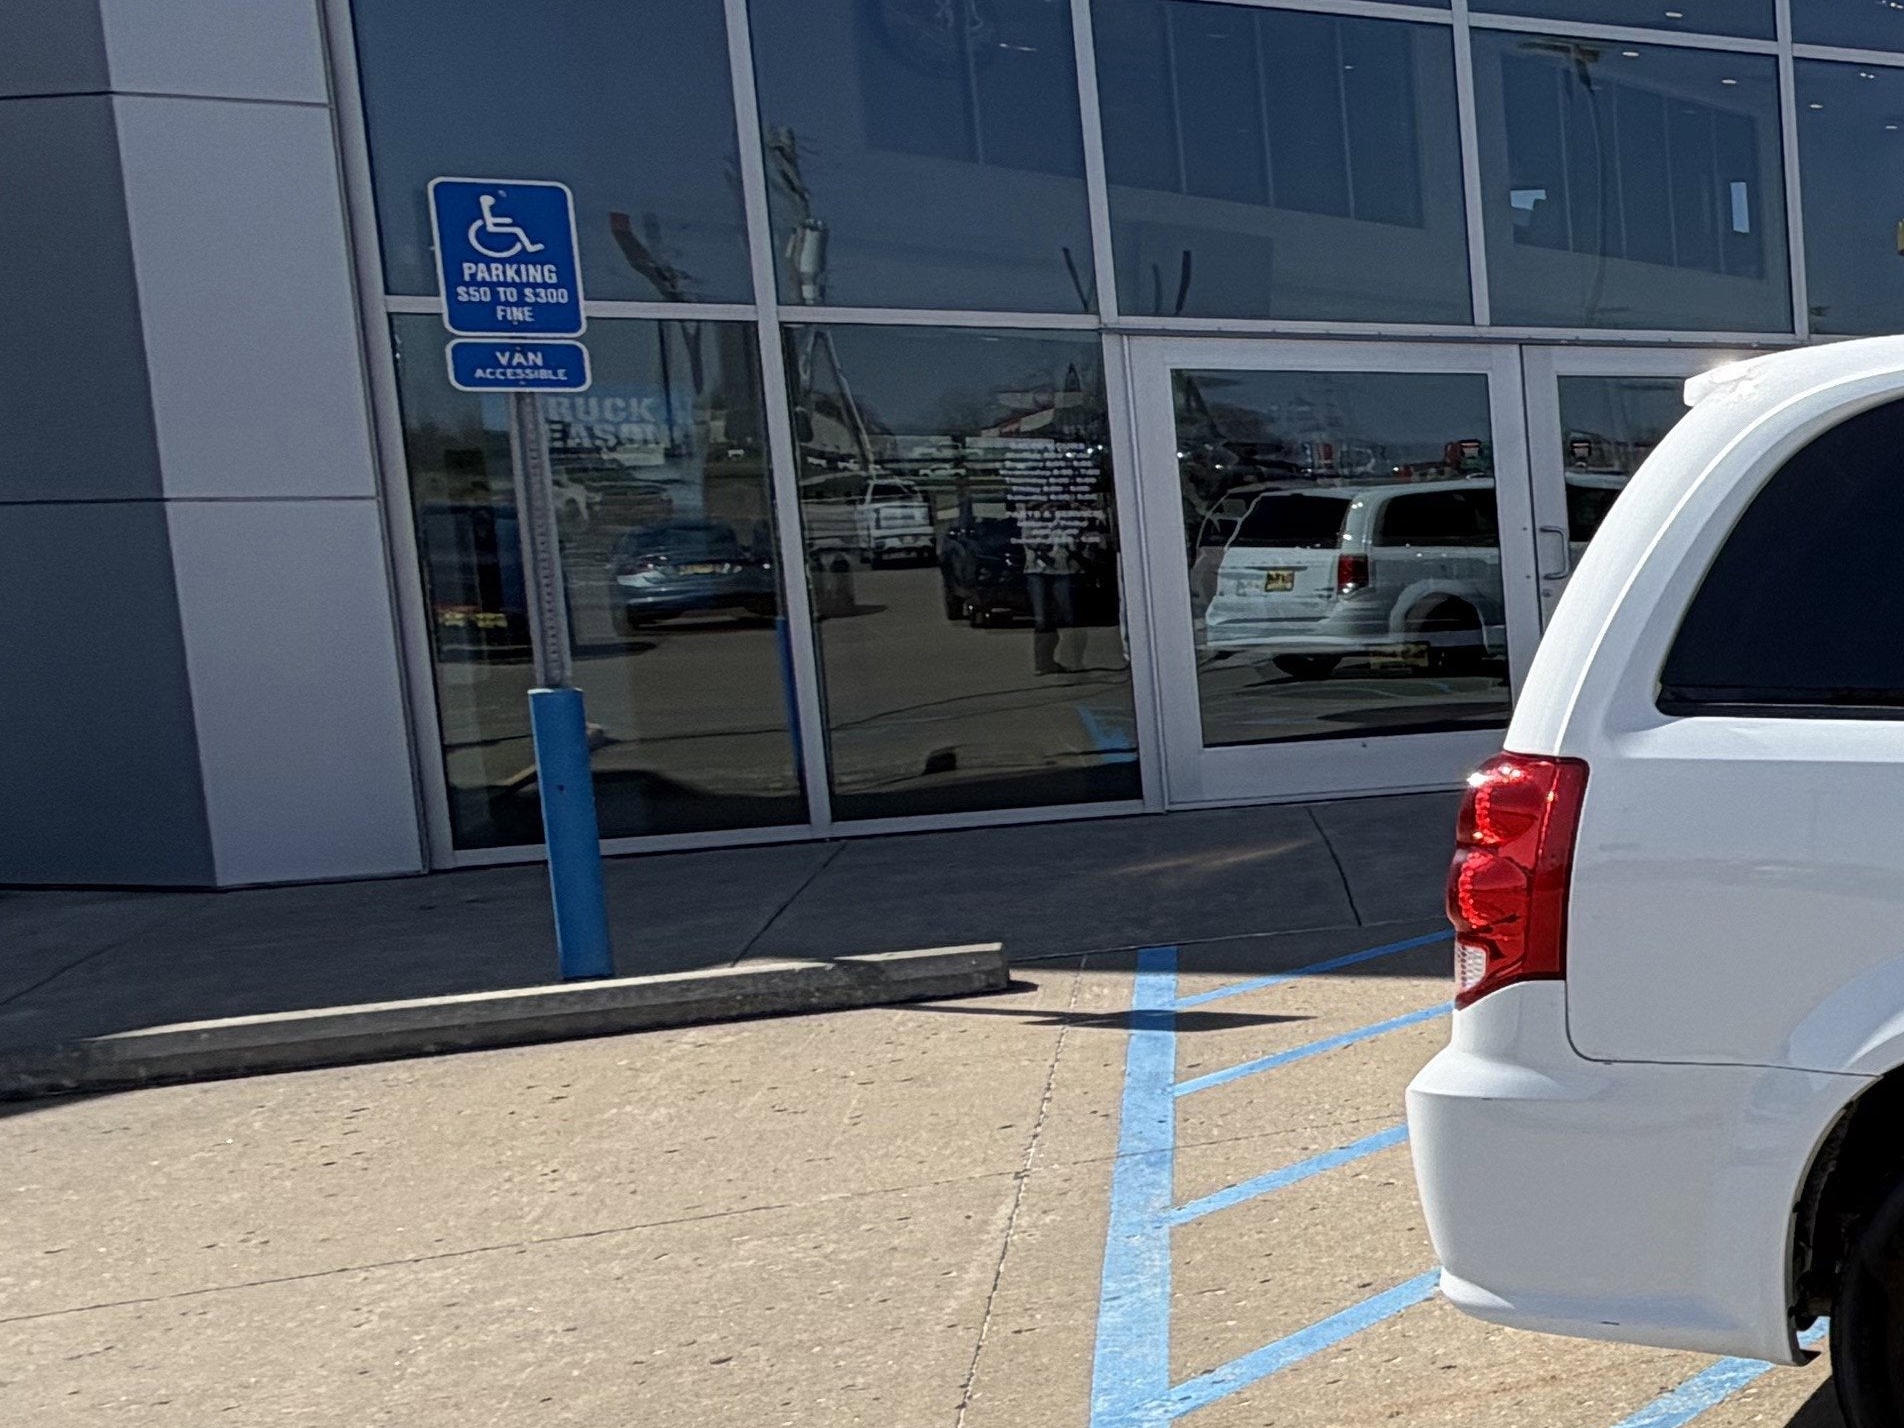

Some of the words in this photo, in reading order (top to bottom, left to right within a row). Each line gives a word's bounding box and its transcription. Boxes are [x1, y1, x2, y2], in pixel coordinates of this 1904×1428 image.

[462, 262, 558, 283] PARKING
[497, 287, 518, 302] TO
[496, 306, 535, 322] FINE
[495, 351, 543, 366] VAN
[474, 368, 567, 380] ACCESSIBLE
[546, 396, 656, 422] RUCK
